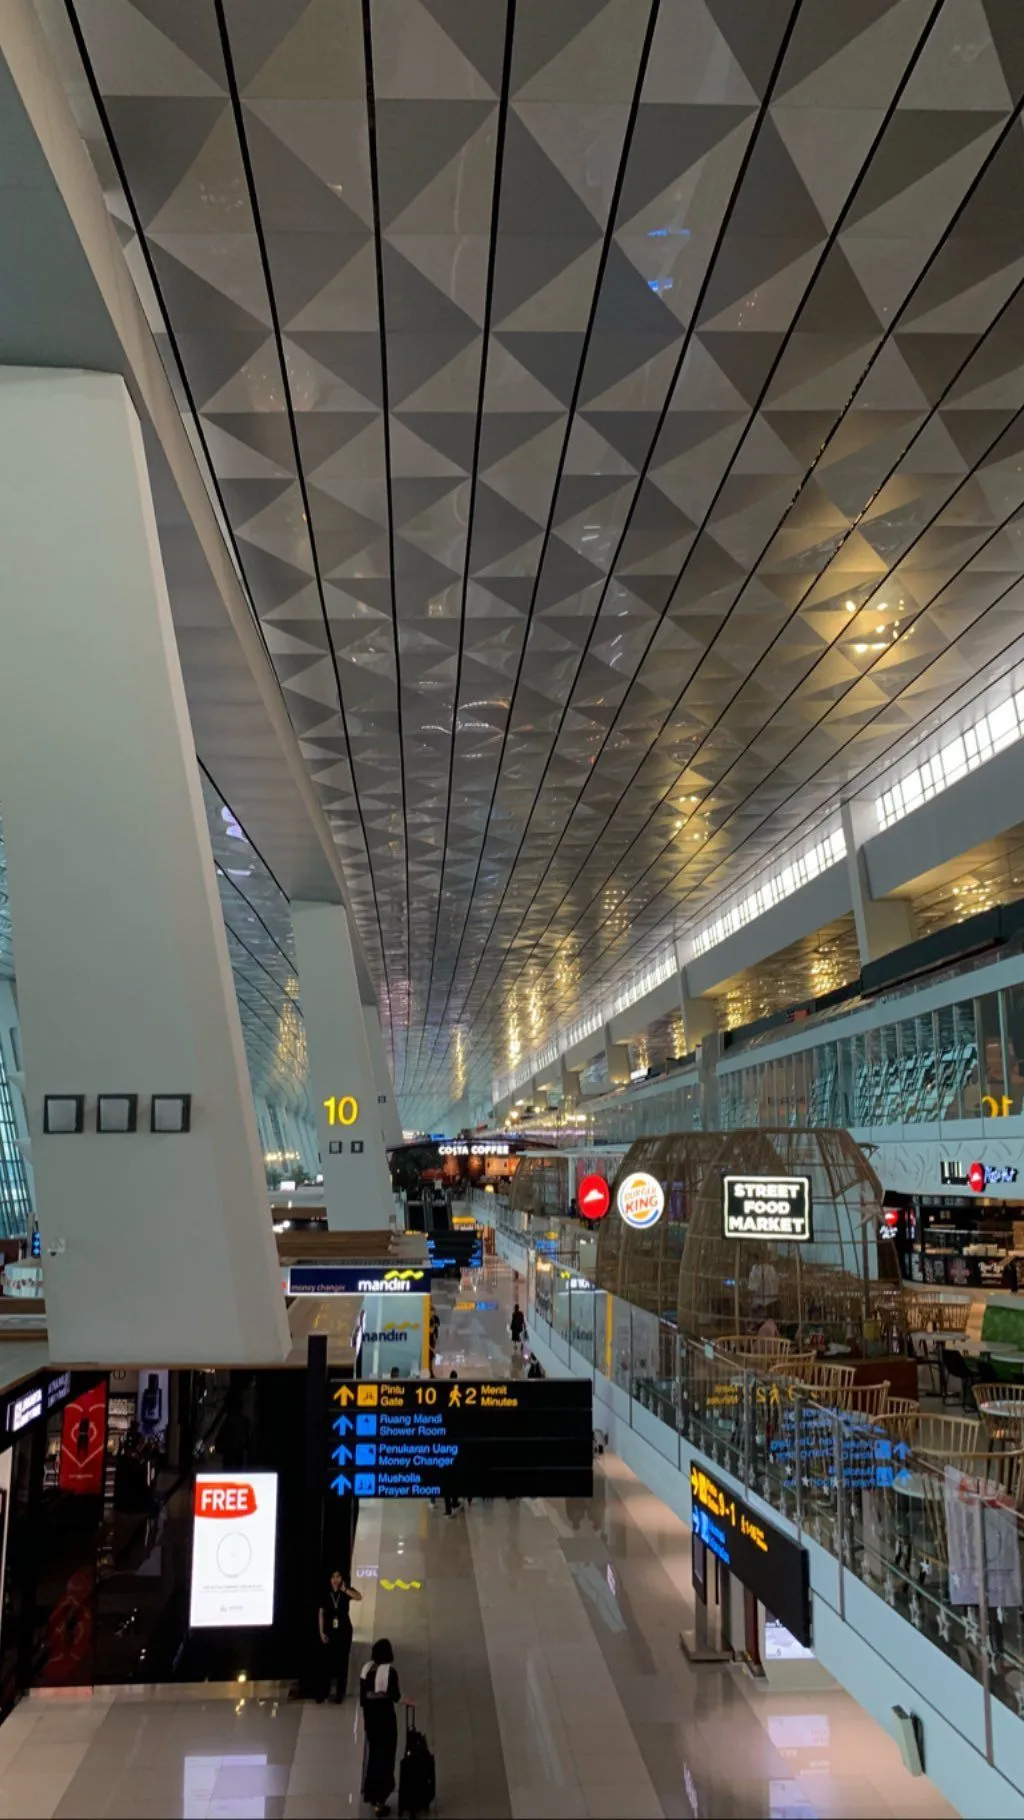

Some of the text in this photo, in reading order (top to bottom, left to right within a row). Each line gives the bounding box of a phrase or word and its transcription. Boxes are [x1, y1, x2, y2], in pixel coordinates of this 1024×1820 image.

[323, 1095, 359, 1126] 10
[438, 1144, 510, 1155] COSTA COFFEE
[734, 1183, 800, 1199] STREET
[625, 1196, 658, 1213] KING
[743, 1201, 791, 1215] FOOD
[729, 1216, 805, 1233] MARKET
[358, 1277, 410, 1291] mandiri
[380, 1385, 405, 1395] Pintu
[416, 1387, 477, 1405] 10 2
[481, 1384, 508, 1395] Menit
[380, 1396, 404, 1407] Gate
[481, 1397, 518, 1407] Minutes
[380, 1413, 443, 1426] Ruang Mandi
[380, 1425, 446, 1437] Shower Room
[379, 1443, 459, 1456] Penukaran Uang
[379, 1455, 454, 1468] Money Changer
[378, 1484, 441, 1497] Prayer Room
[201, 1488, 249, 1511] FREE
